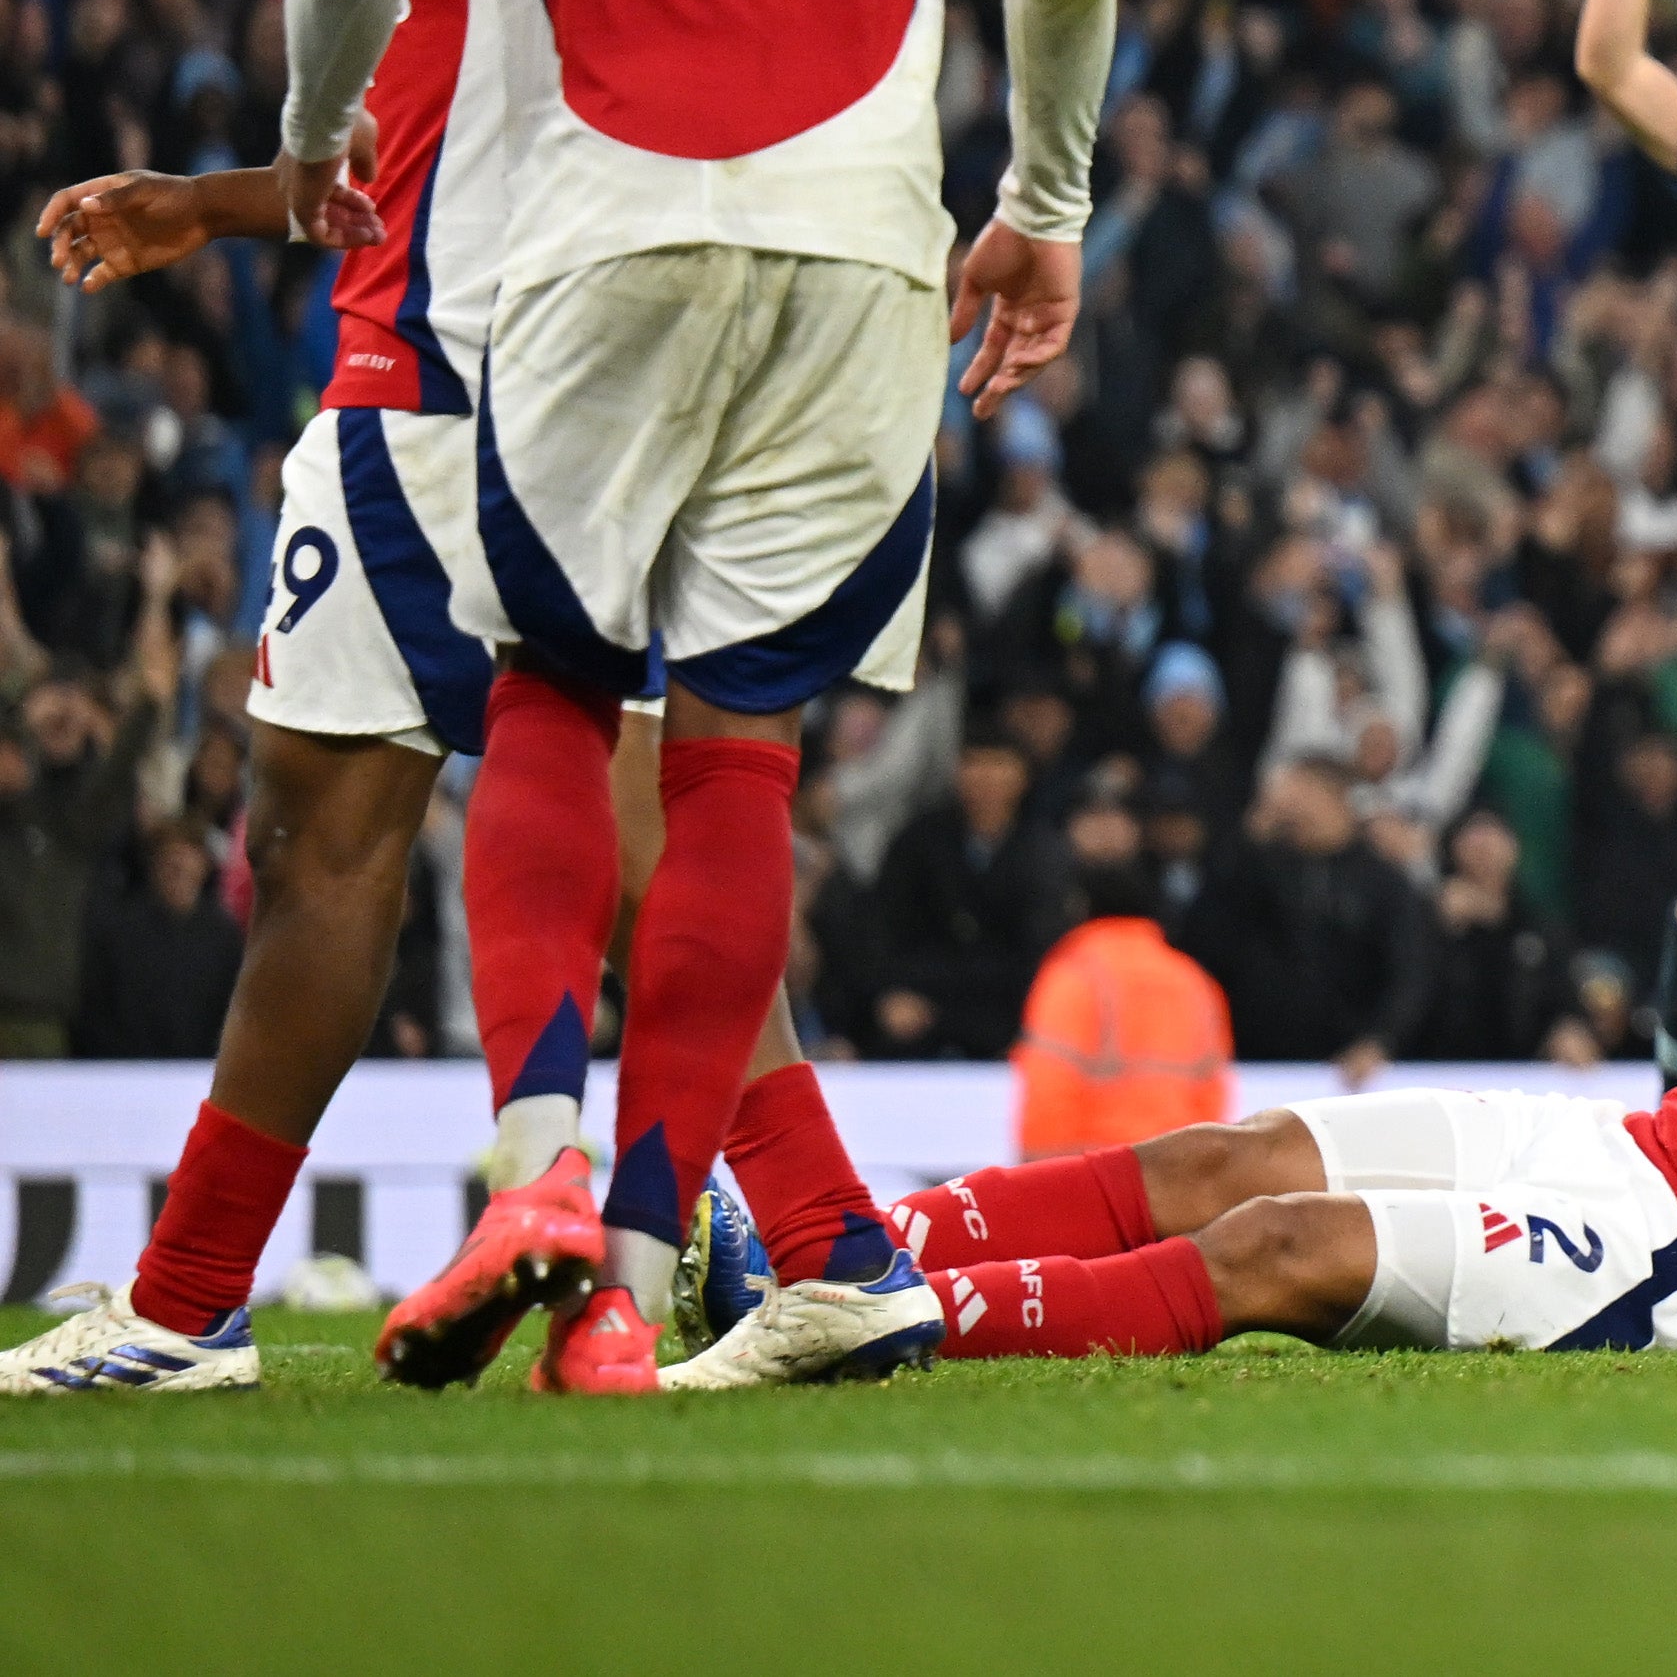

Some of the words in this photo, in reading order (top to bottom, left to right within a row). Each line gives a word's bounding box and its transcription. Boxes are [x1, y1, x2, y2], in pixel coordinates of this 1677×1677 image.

[266, 525, 340, 634] 9
[944, 1177, 989, 1241] AFC
[1526, 1212, 1606, 1274] 2
[1016, 1259, 1044, 1329] AFC
